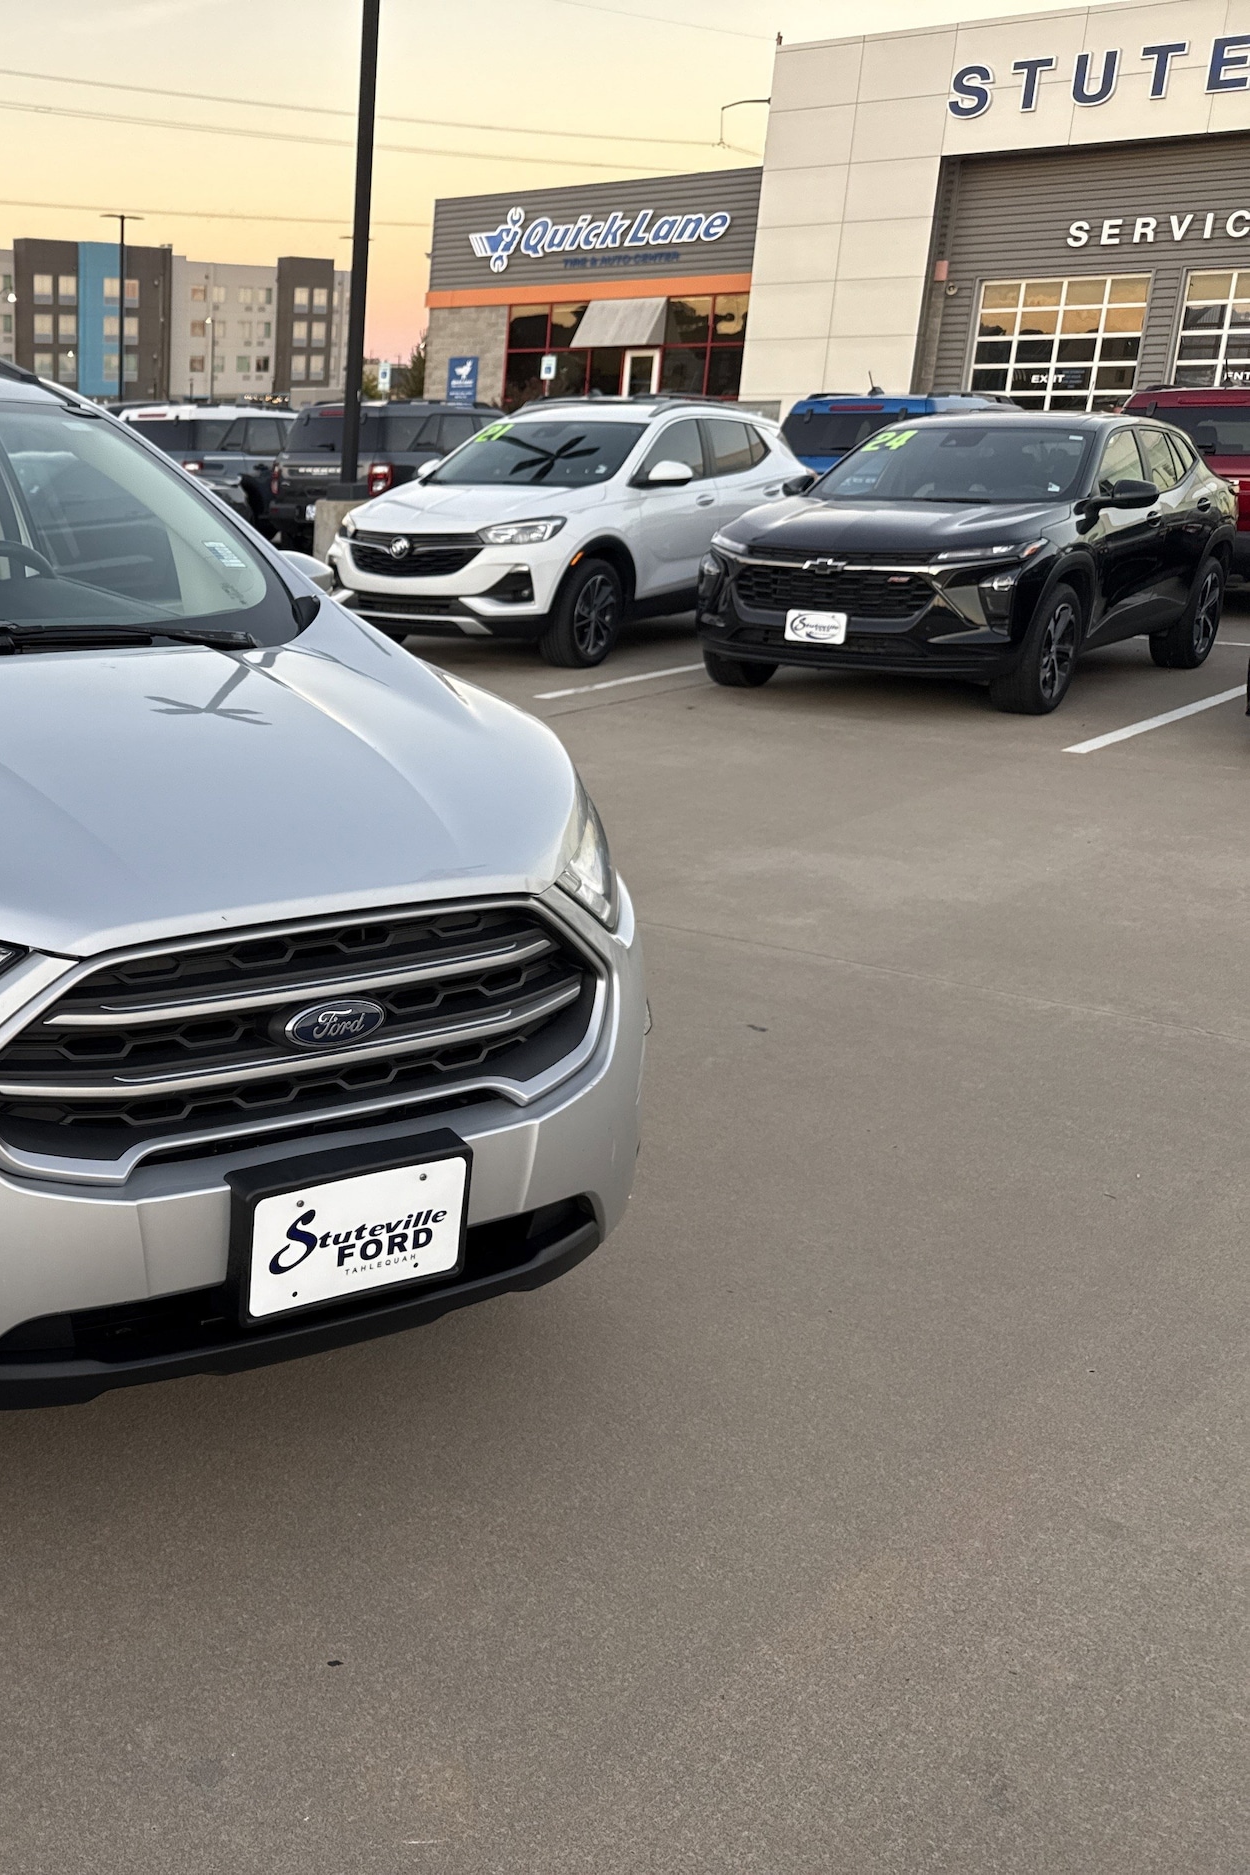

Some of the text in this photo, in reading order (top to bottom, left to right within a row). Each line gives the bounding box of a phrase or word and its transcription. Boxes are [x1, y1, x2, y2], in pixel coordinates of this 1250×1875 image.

[948, 34, 1250, 119] STUTE
[520, 209, 731, 258] Quick Lane
[1066, 209, 1250, 248] SERVIC
[599, 254, 632, 266] AUTO
[633, 251, 680, 265] CENTER
[1031, 374, 1066, 384] EXIT
[474, 423, 515, 442] 21
[860, 430, 918, 452] 24
[313, 1009, 366, 1039] Ford
[269, 1209, 447, 1275] Stuteville
[337, 1227, 433, 1267] FORD
[345, 1254, 416, 1275] TAHLEQUAH
